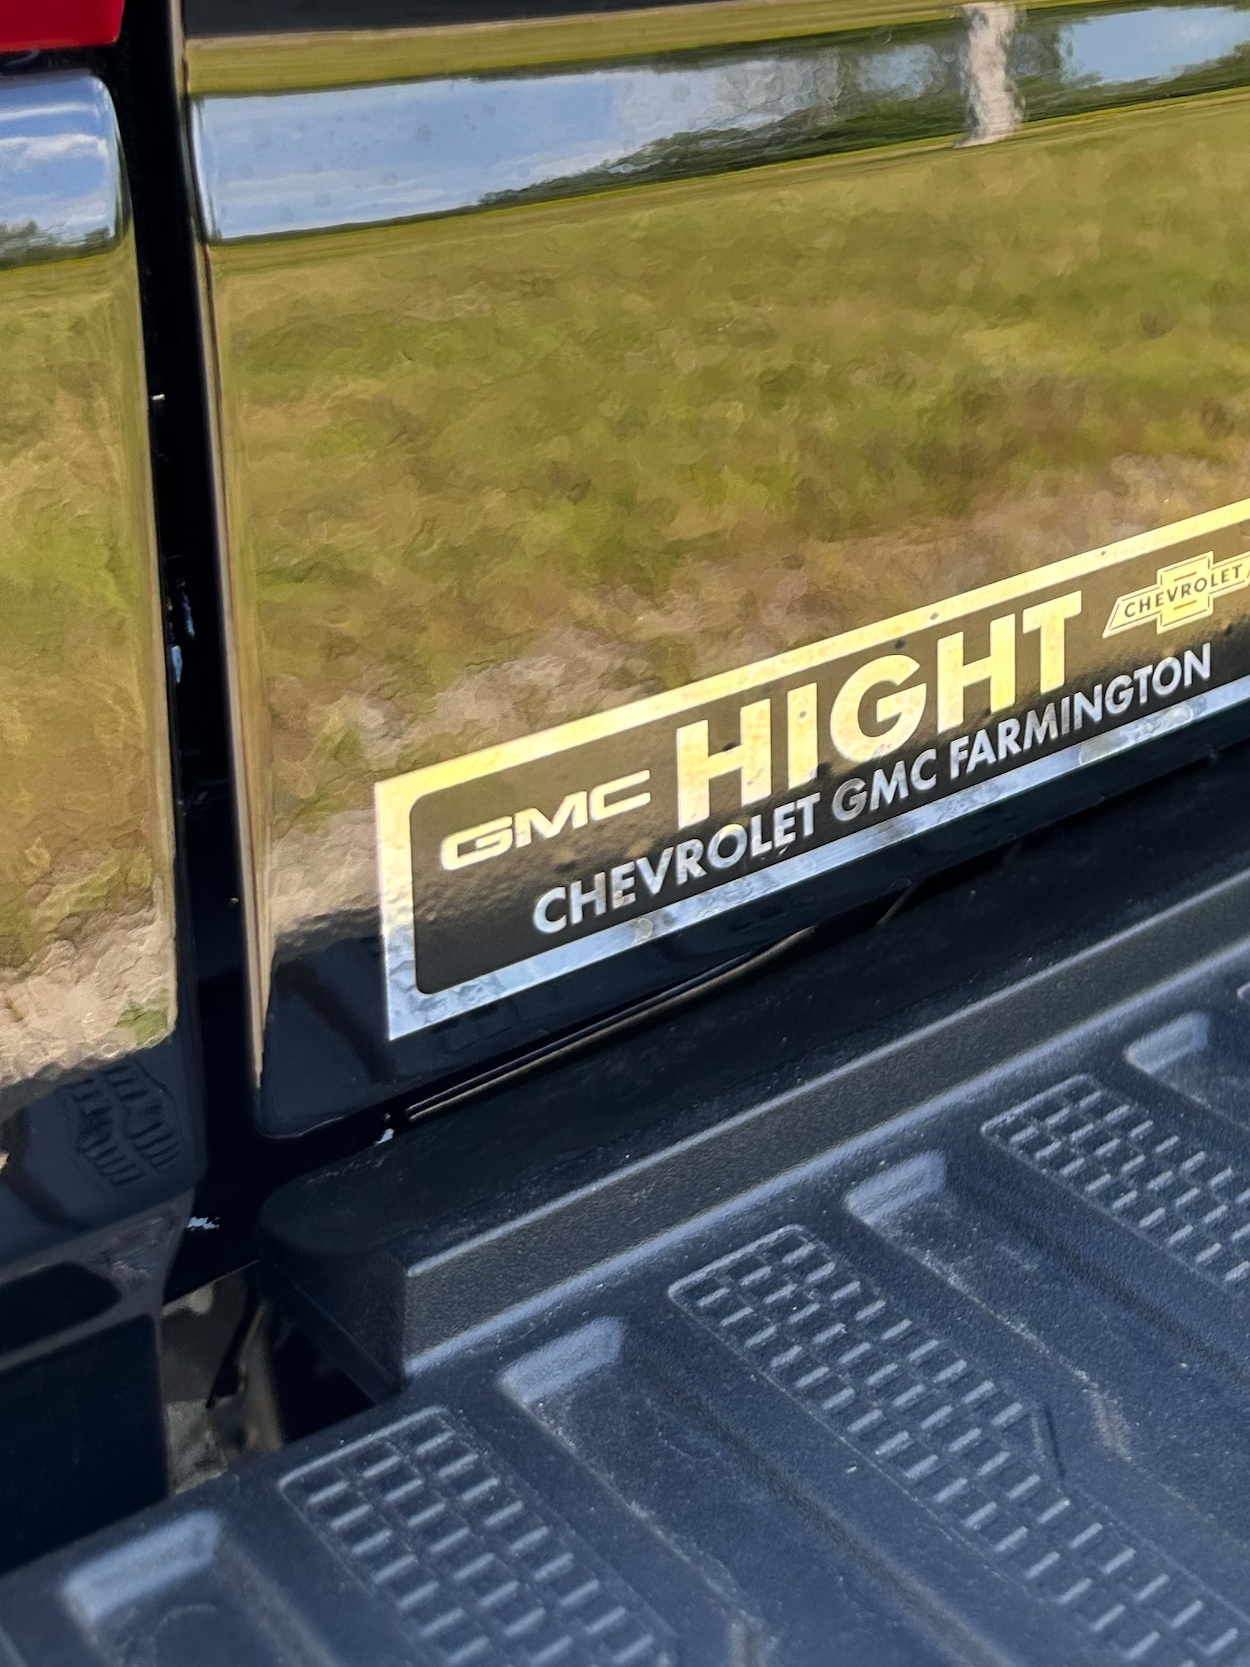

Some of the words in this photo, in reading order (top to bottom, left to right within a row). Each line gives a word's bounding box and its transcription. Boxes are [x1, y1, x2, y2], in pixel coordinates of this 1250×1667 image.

[1123, 563, 1244, 619] CHEVROLET
[532, 792, 820, 934] CHEVROLET
[831, 748, 937, 822] GMC
[949, 642, 1211, 780] FARMINGTON
[676, 591, 1082, 829] HIGHT
[440, 769, 651, 871] GMC
